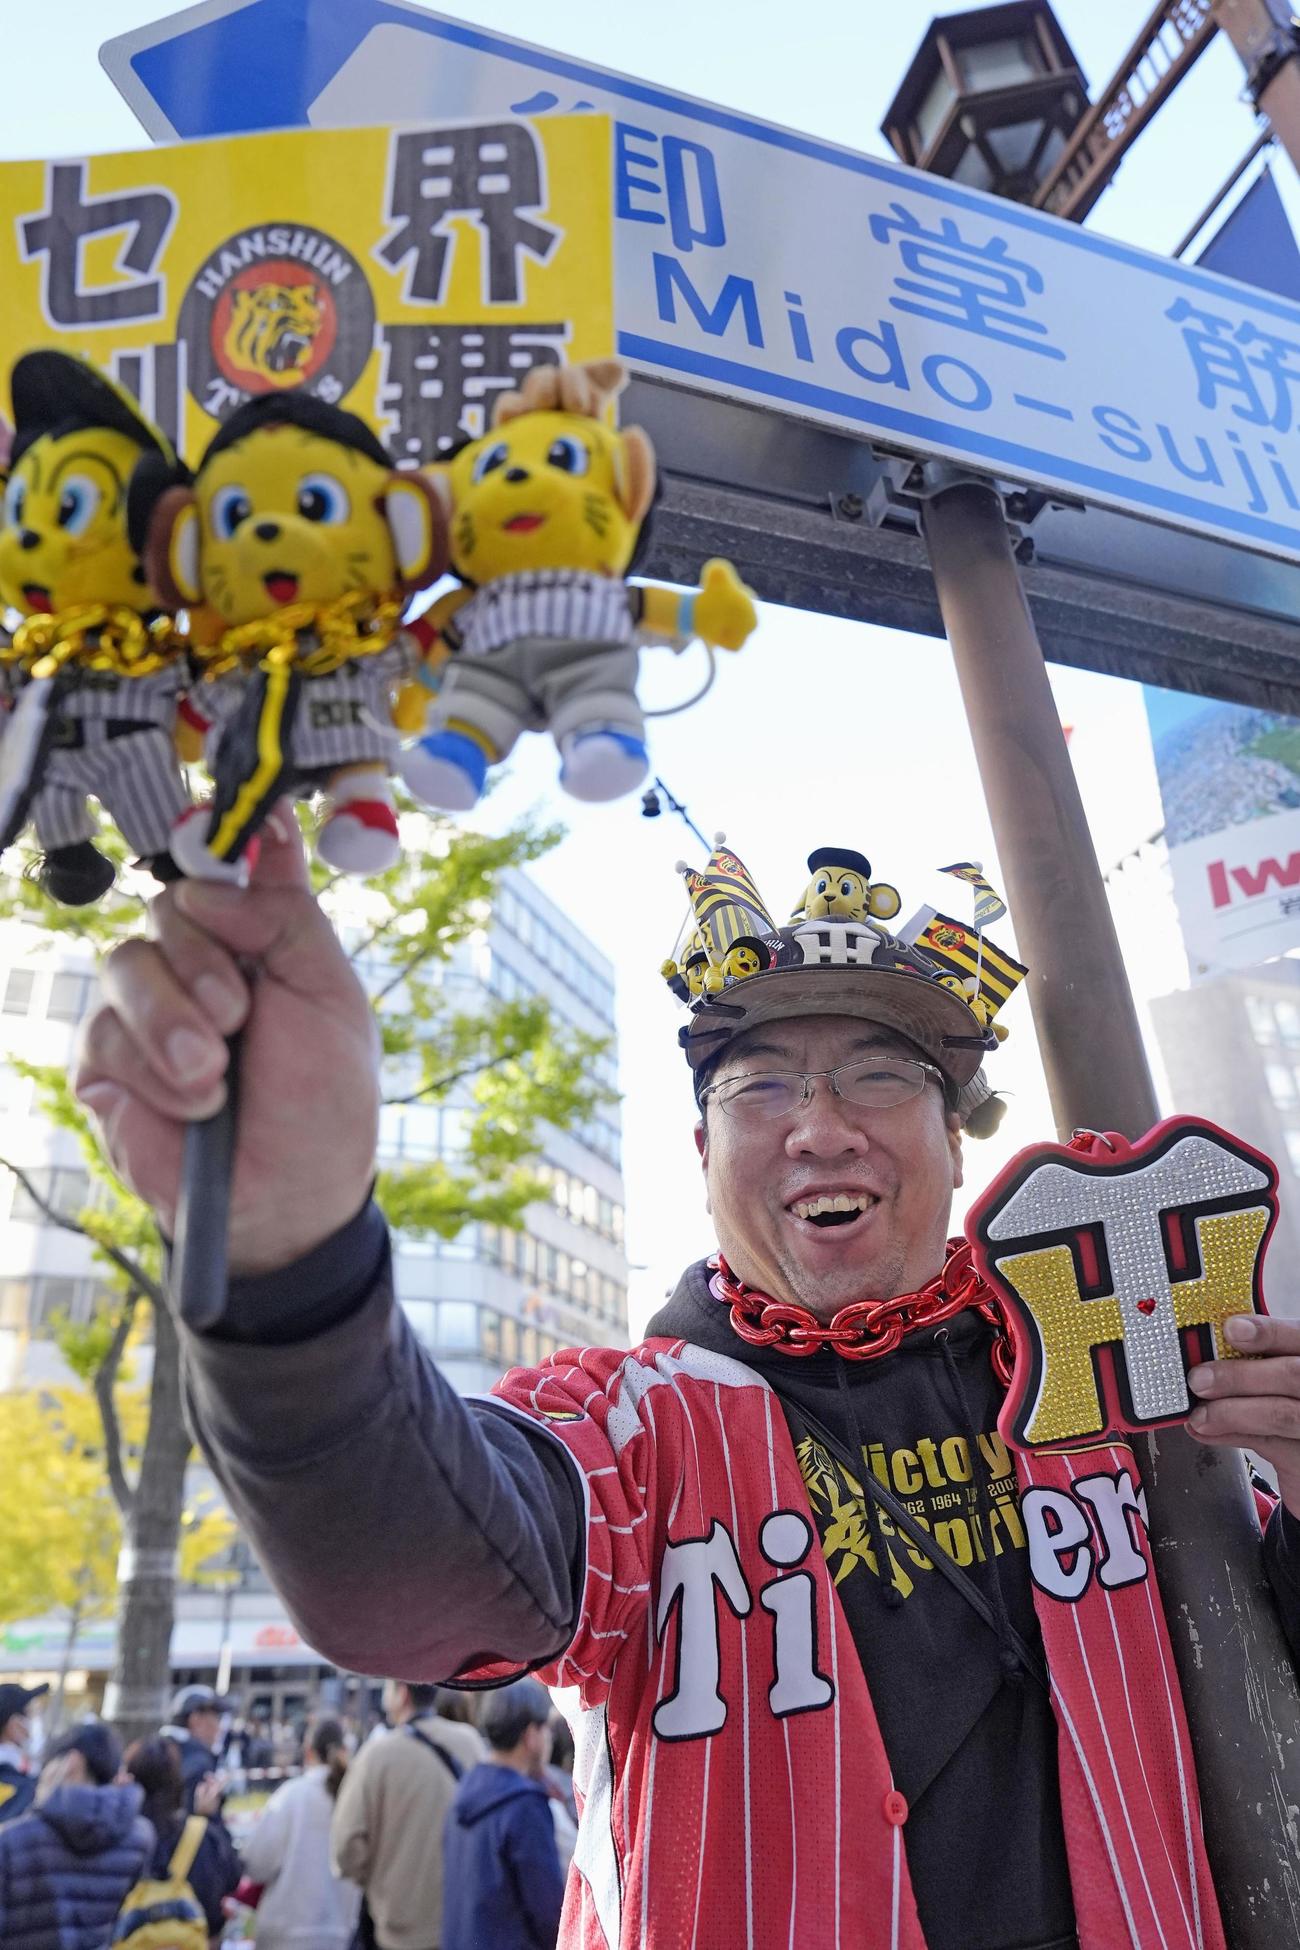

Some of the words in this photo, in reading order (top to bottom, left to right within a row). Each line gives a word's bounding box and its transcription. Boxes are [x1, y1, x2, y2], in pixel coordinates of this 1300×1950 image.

[195, 229, 351, 298] HANSHIN
[901, 1500, 926, 1515] 62
[931, 1492, 961, 1511] 1964
[651, 1508, 835, 1743] Ti
[1020, 1467, 1150, 1602] er
